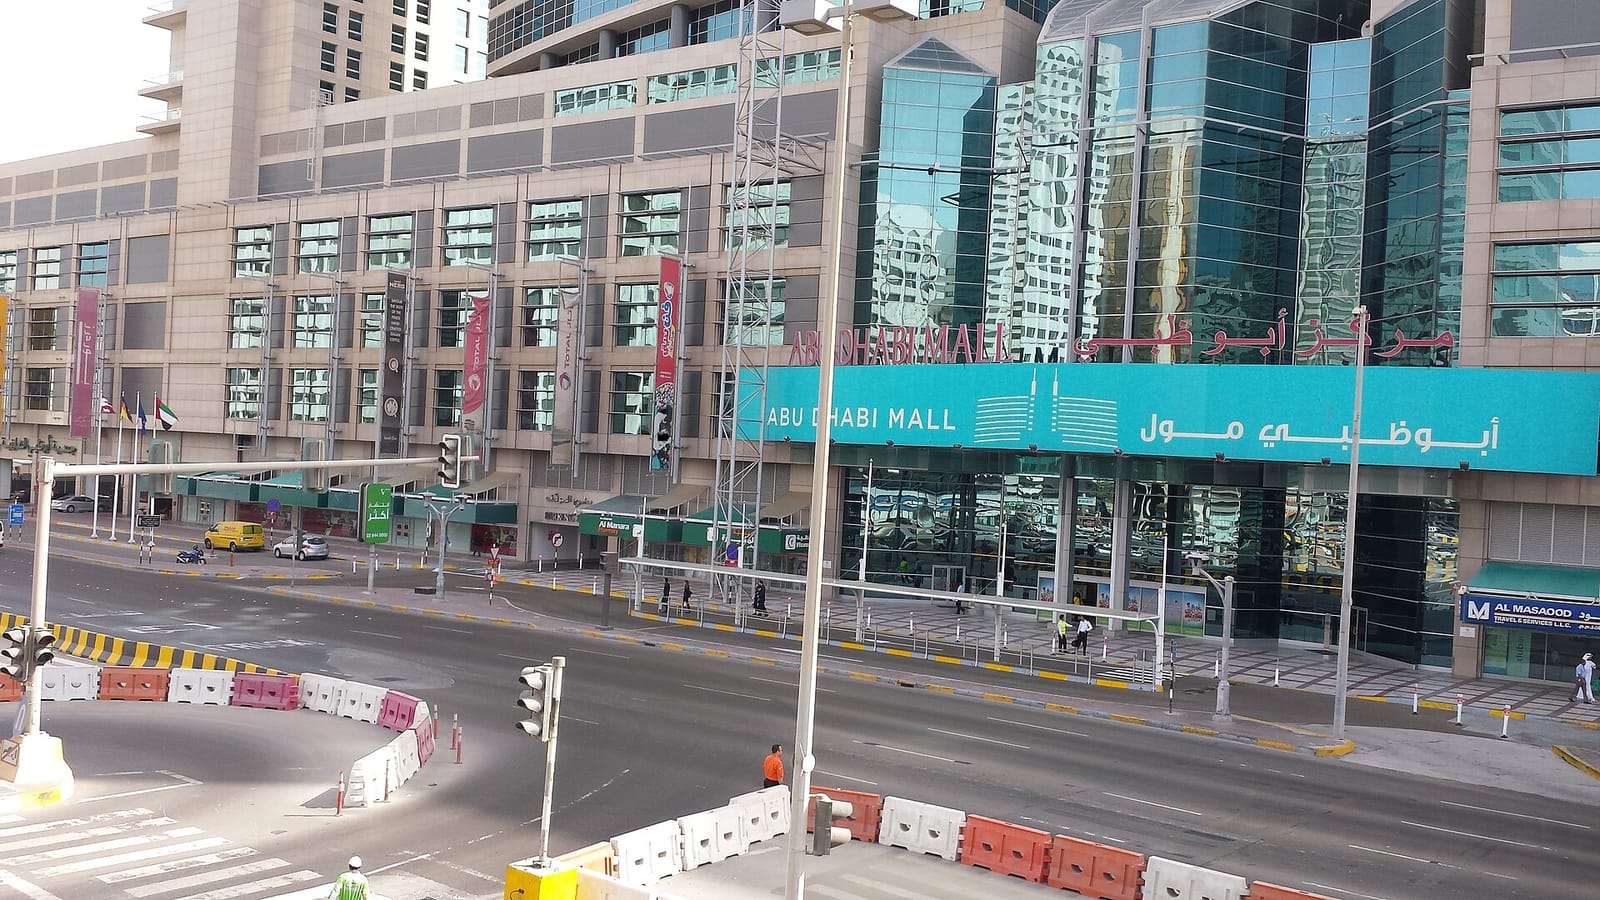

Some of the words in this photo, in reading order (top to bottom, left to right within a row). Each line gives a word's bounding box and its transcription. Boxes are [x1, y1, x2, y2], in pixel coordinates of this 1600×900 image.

[564, 333, 572, 368] TOTAL
[837, 326, 915, 365] DHABI
[922, 322, 1013, 364] MALL
[1294, 314, 1454, 358] مركز
[473, 336, 481, 370] TOTAL
[767, 407, 803, 426] ABU
[888, 408, 956, 430] MALL
[1141, 413, 1244, 443] مول
[1258, 416, 1499, 457] أبوظبي
[368, 508, 389, 521] أكثر
[1494, 603, 1511, 612] AL
[1513, 604, 1572, 618] MASAOOD
[1494, 615, 1517, 623] TRAVEL
[1523, 618, 1553, 627] SERVICES
